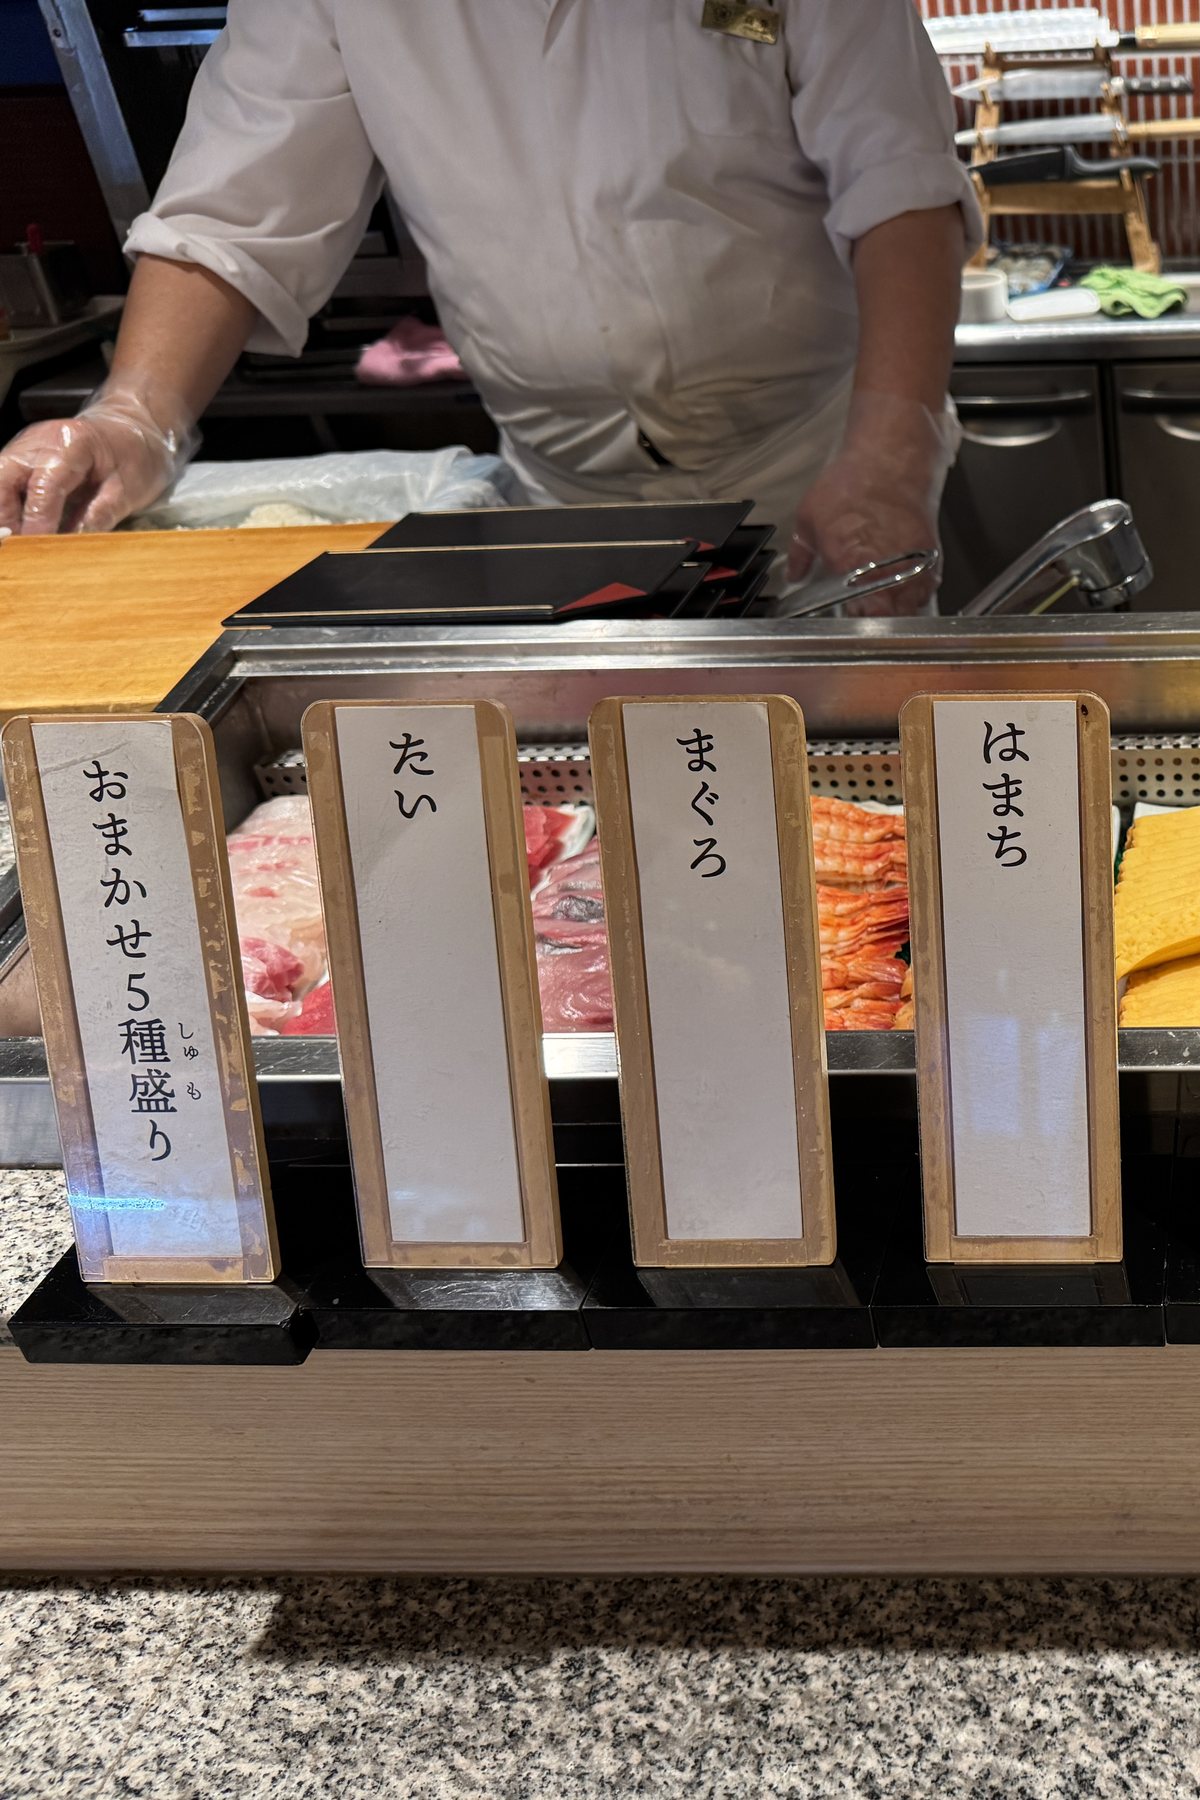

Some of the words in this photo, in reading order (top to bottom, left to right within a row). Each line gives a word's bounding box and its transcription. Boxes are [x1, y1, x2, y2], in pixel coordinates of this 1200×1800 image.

[388, 732, 437, 819] たい
[675, 728, 727, 878] まぐろ
[982, 720, 1030, 868] はまち
[82, 760, 179, 1162] おまかせ5種盛り
